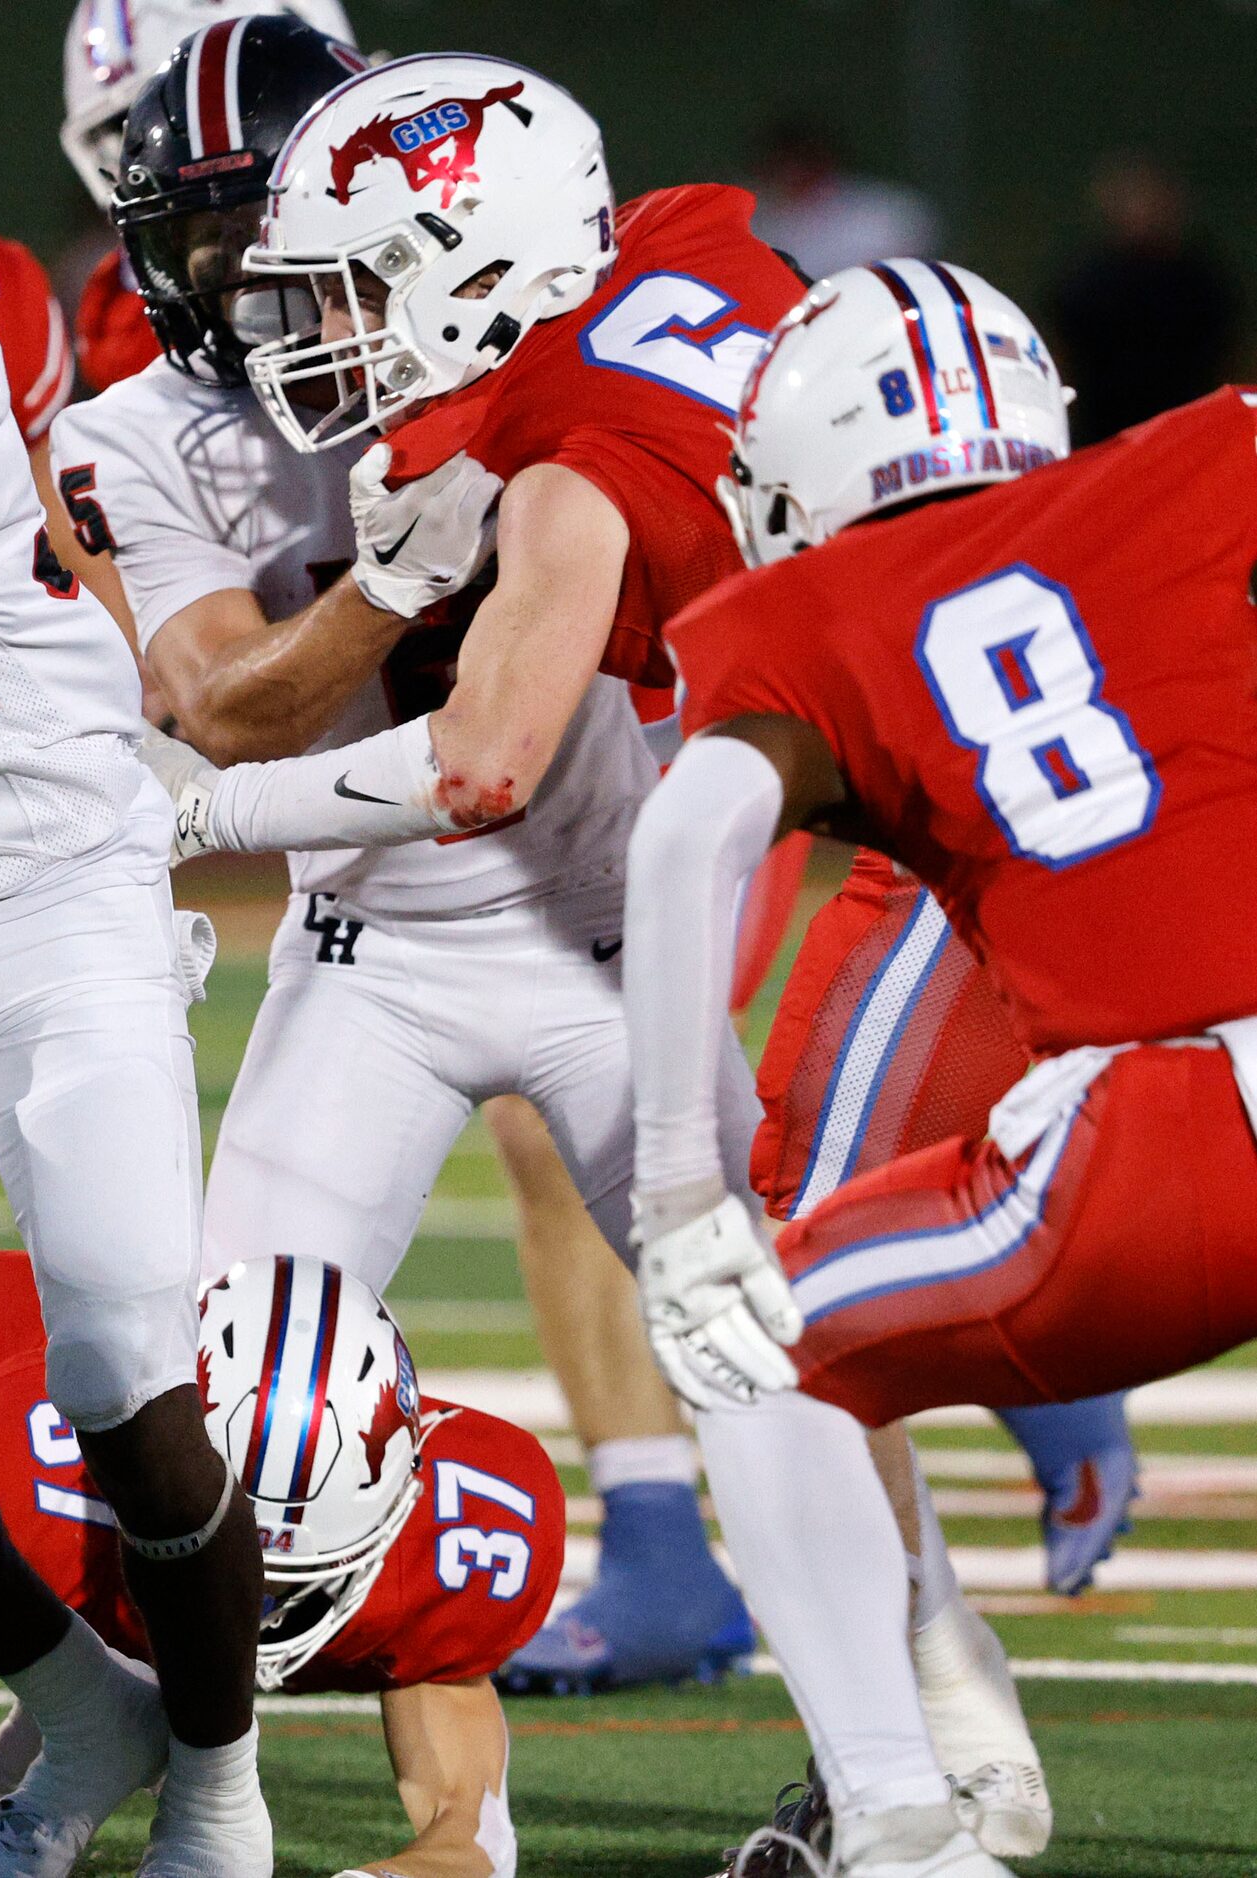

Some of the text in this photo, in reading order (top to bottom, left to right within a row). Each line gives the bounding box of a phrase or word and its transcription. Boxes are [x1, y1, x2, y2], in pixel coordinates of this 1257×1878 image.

[390, 102, 470, 153] GHS
[878, 367, 916, 418] 8
[59, 462, 118, 557] 5
[912, 560, 1165, 872] 8
[432, 1457, 537, 1603] 37
